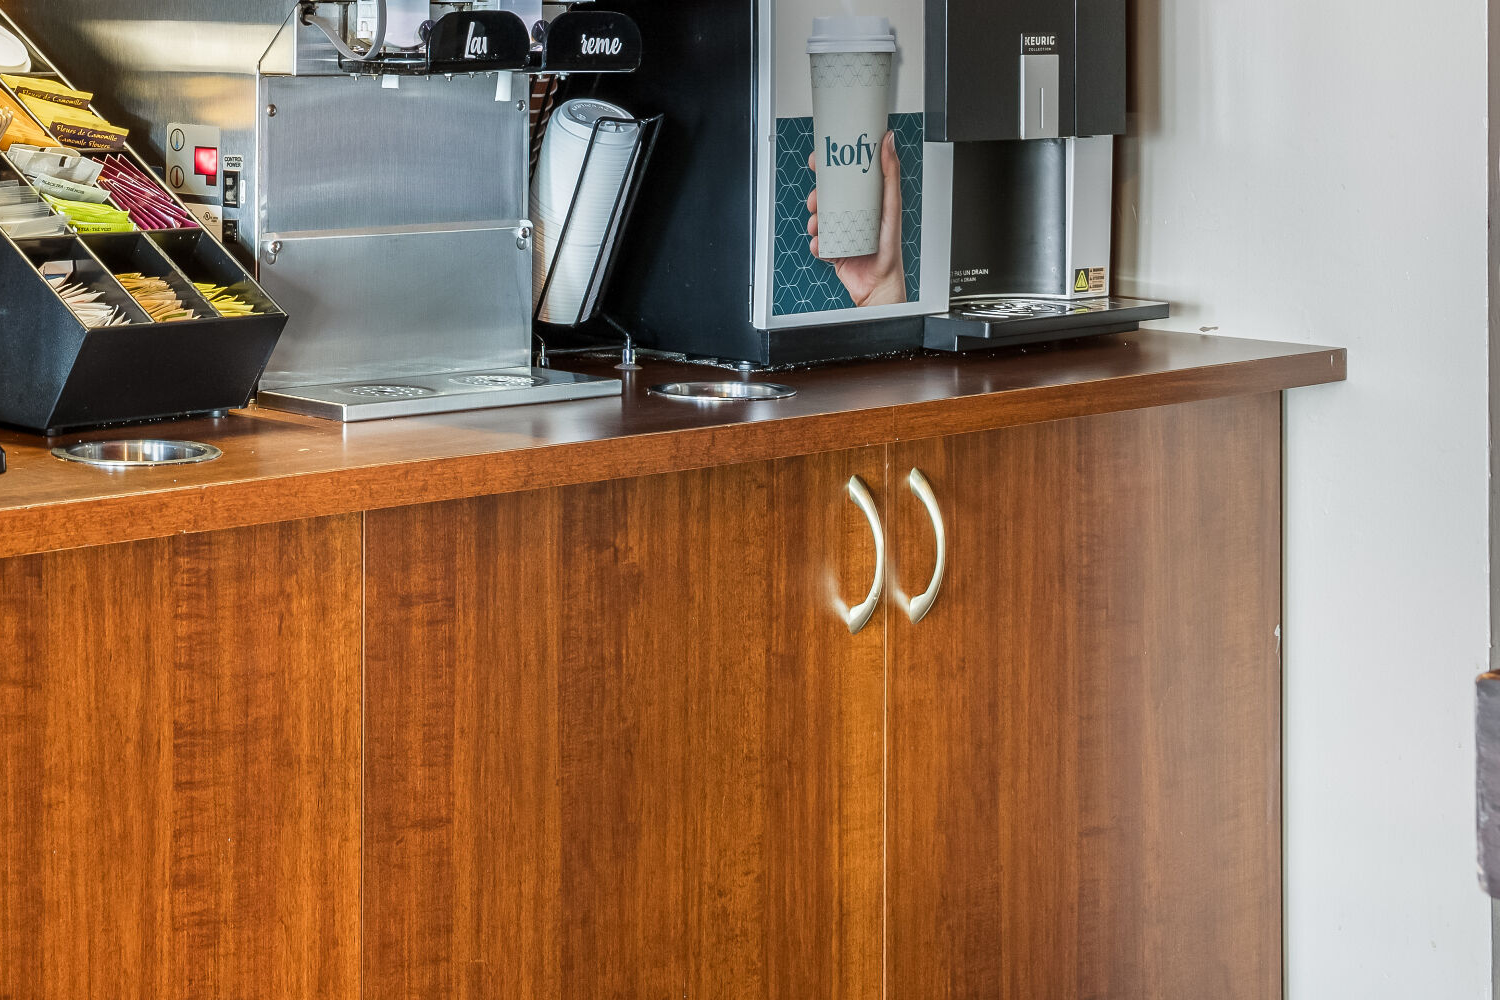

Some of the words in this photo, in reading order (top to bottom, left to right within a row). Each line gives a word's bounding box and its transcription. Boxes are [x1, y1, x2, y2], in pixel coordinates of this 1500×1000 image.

[1024, 36, 1056, 46] KEURIG
[42, 93, 51, 101] de
[52, 96, 82, 106] Camomille
[56, 124, 76, 135] Fleurs
[77, 128, 86, 137] de
[87, 130, 118, 142] Camomille
[824, 133, 877, 173] kofy
